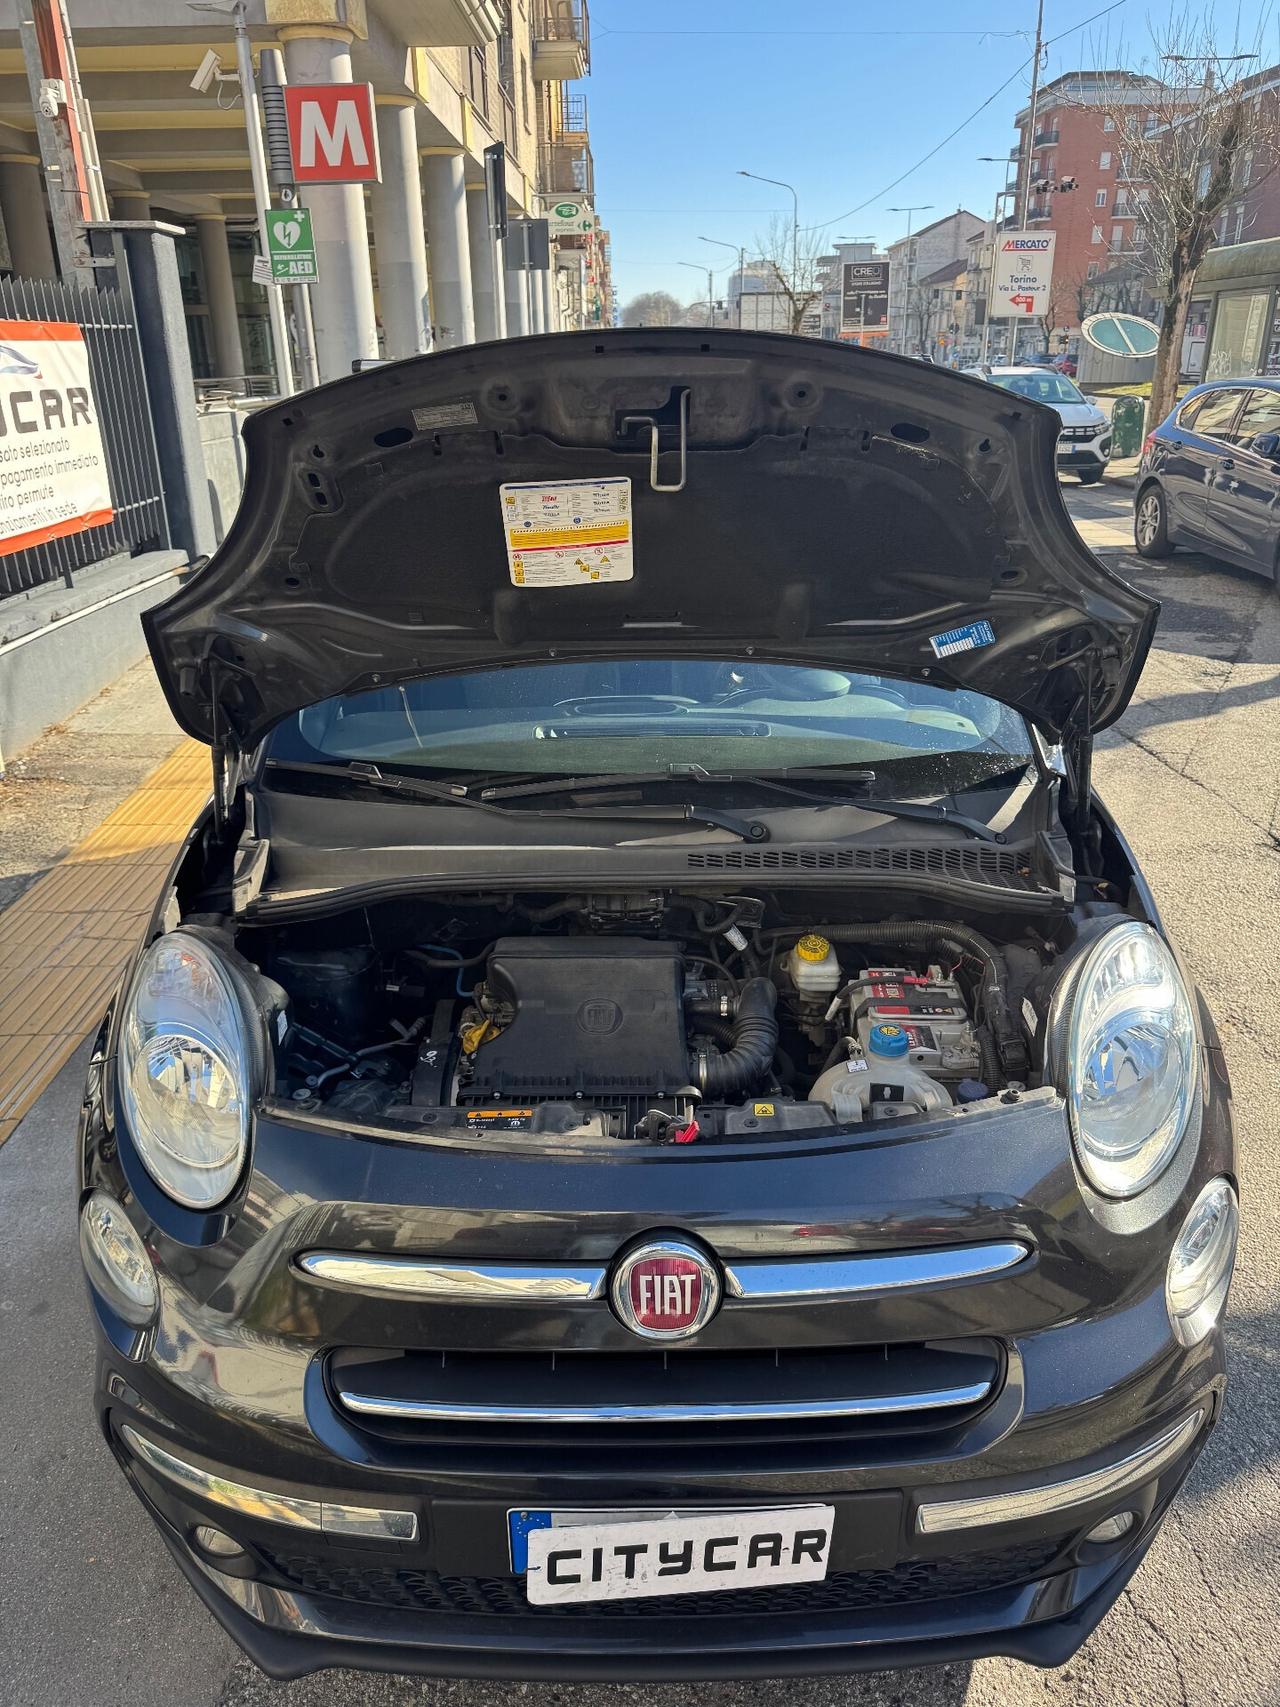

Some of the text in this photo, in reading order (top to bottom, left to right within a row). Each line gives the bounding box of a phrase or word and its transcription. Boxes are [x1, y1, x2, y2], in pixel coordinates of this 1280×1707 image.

[300, 100, 369, 167] M
[288, 261, 314, 275] AED
[1009, 274, 1037, 284] Torino
[0, 386, 92, 437] CAR
[19, 436, 70, 459] selezionato
[1, 452, 99, 489] pagamento immediato
[16, 484, 54, 510] permute
[640, 1274, 697, 1315] FIAT
[546, 1528, 827, 1585] CITYCAR
